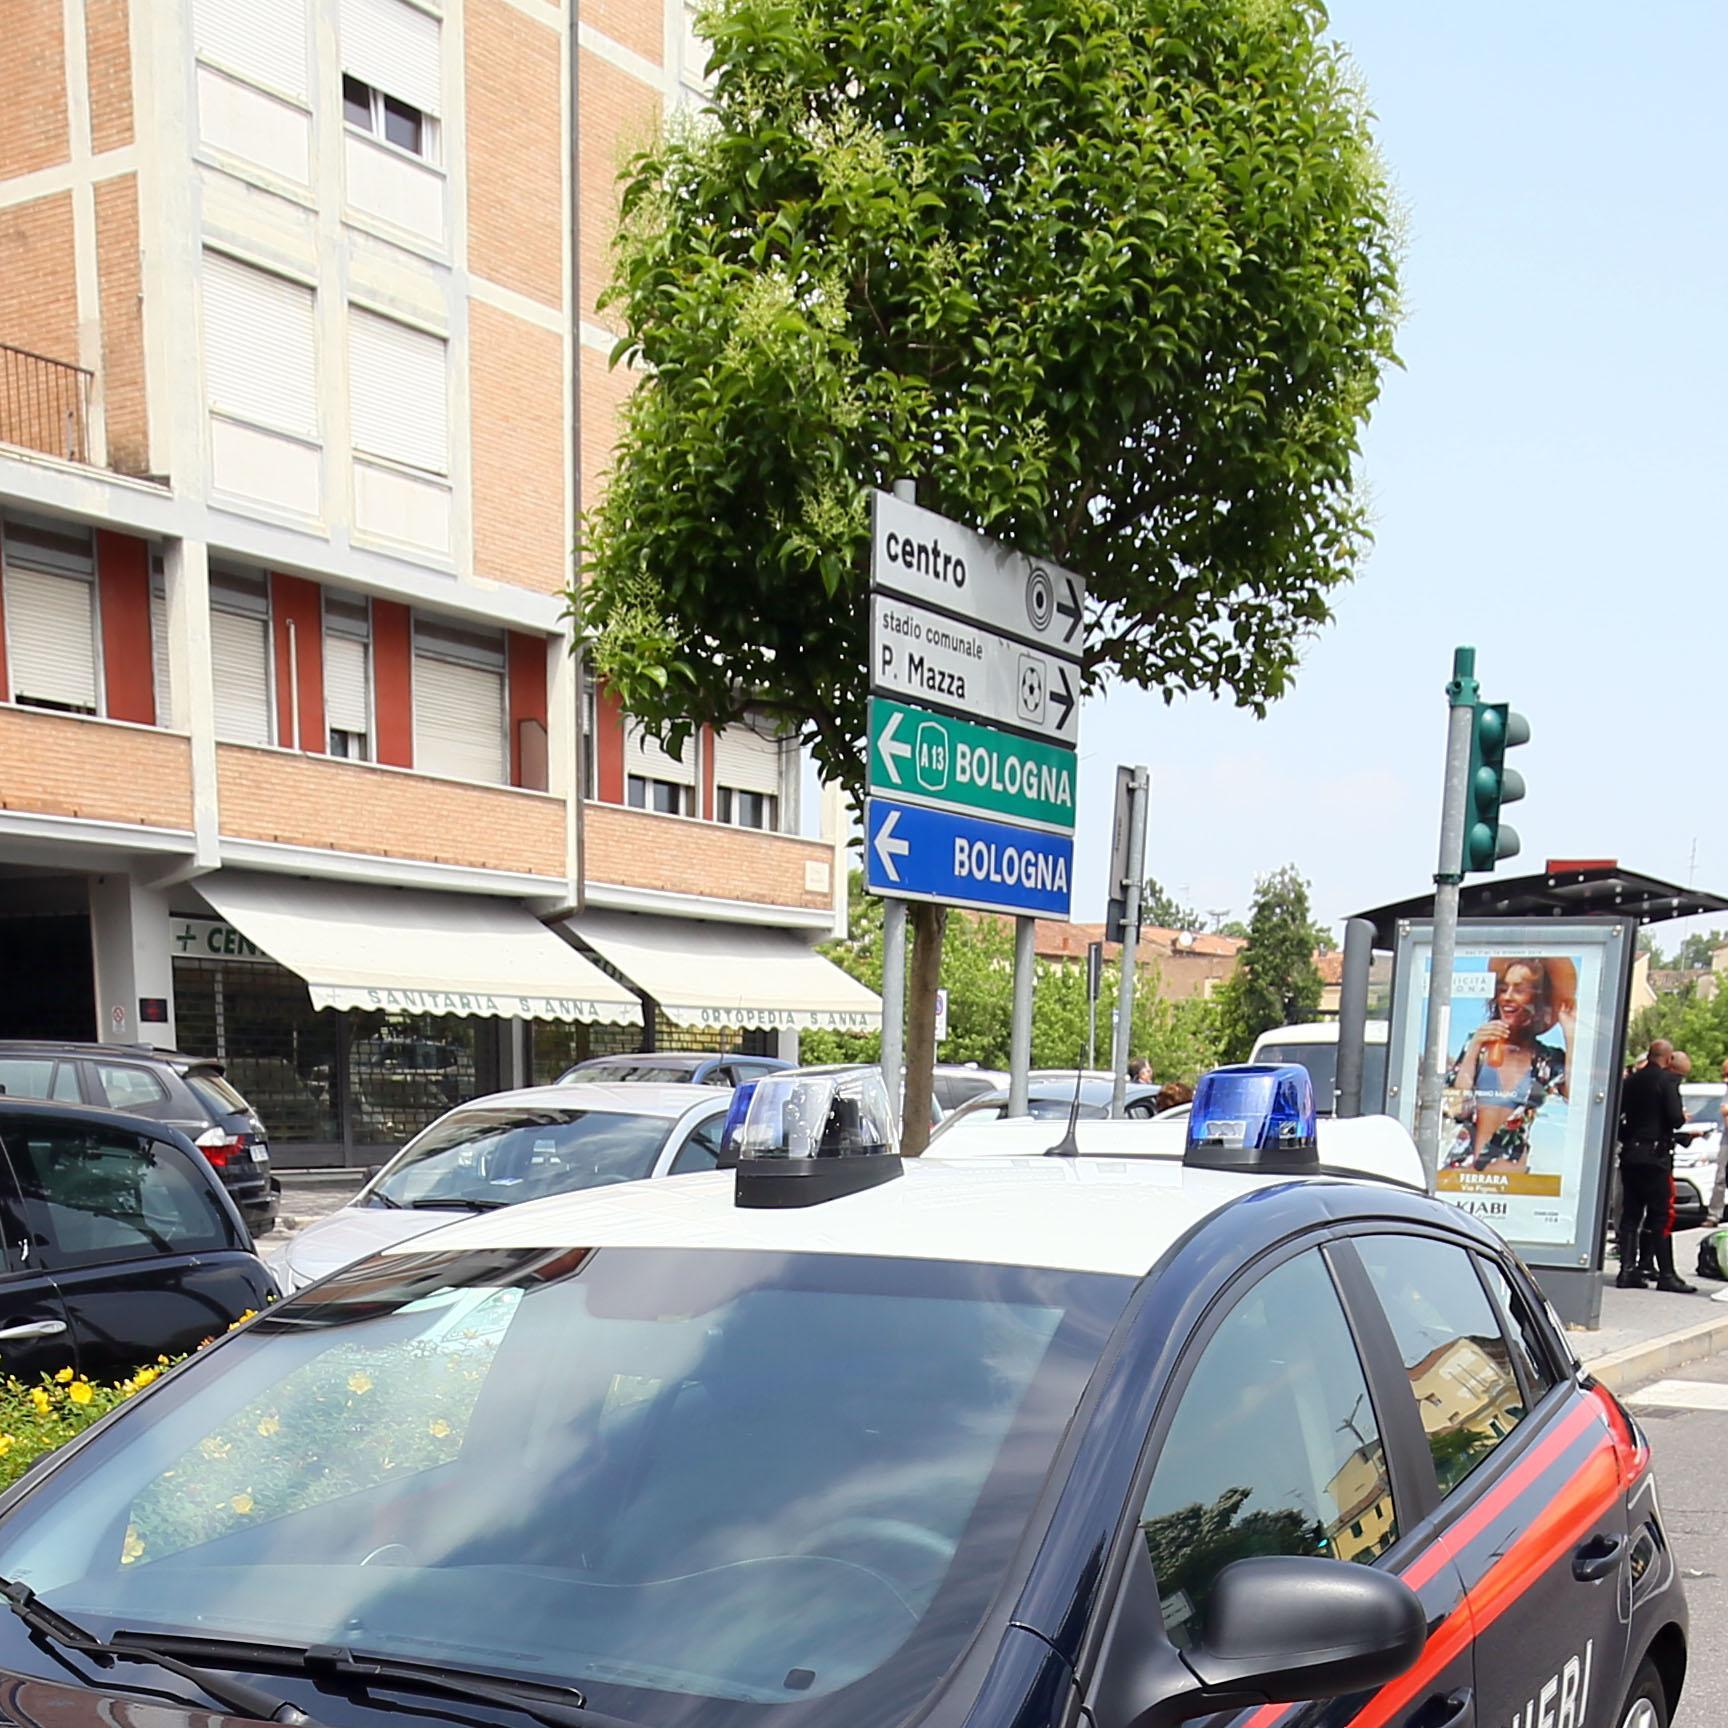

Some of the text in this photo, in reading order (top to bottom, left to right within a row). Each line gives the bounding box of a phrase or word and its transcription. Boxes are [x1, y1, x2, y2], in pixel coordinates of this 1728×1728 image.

[886, 532, 967, 588] centro
[882, 611, 984, 661] stadio comunale
[881, 644, 966, 700] P. Mazza
[920, 743, 945, 772] A 13
[955, 742, 1072, 808] BOLOGNA
[954, 837, 1068, 894] BOLOGNA
[367, 990, 499, 1010] SANITARIA
[701, 1007, 795, 1025] ORTOPEDIA
[1459, 1173, 1509, 1185] FERRARA
[1457, 1200, 1508, 1215] KIABI
